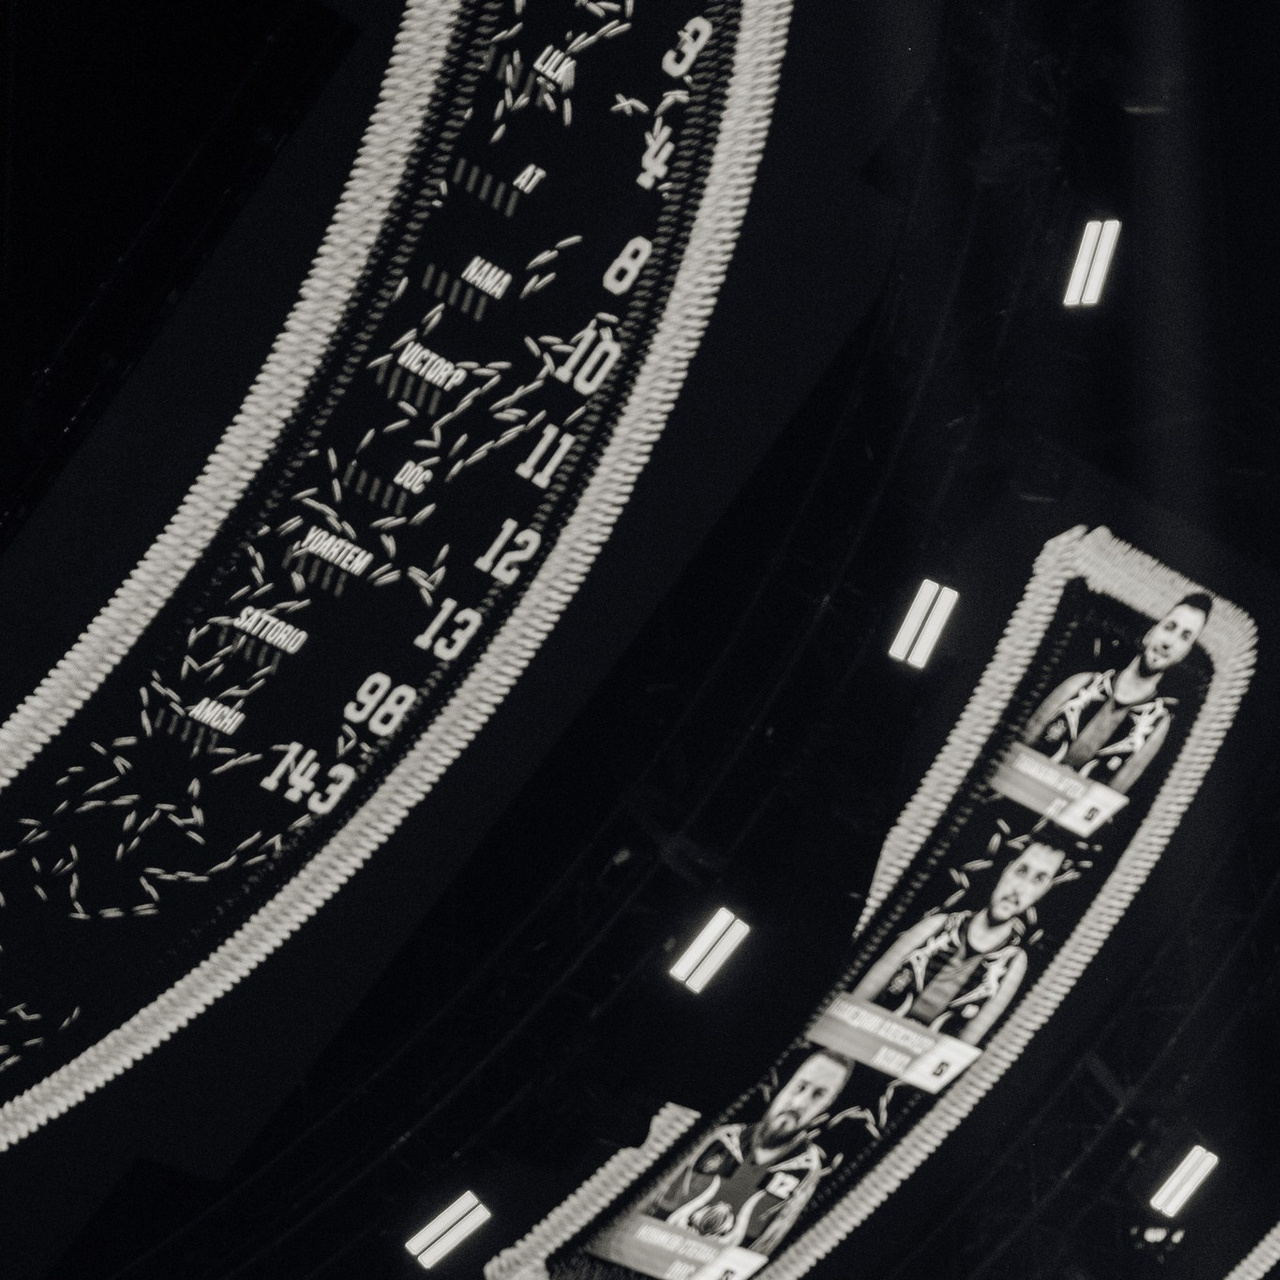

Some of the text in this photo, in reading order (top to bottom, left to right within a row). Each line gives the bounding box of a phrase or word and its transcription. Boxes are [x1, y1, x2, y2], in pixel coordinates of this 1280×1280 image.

[662, 16, 713, 77] 3
[513, 164, 546, 194] AT
[461, 255, 513, 300] NAMA
[602, 235, 653, 296] 8
[554, 330, 622, 396] 10
[393, 460, 433, 495] DOC
[515, 422, 576, 489] 11
[474, 518, 542, 586] 12
[233, 606, 309, 655] SATTORIO
[413, 598, 483, 661] 13
[344, 671, 418, 737] 98
[260, 742, 357, 815] 143
